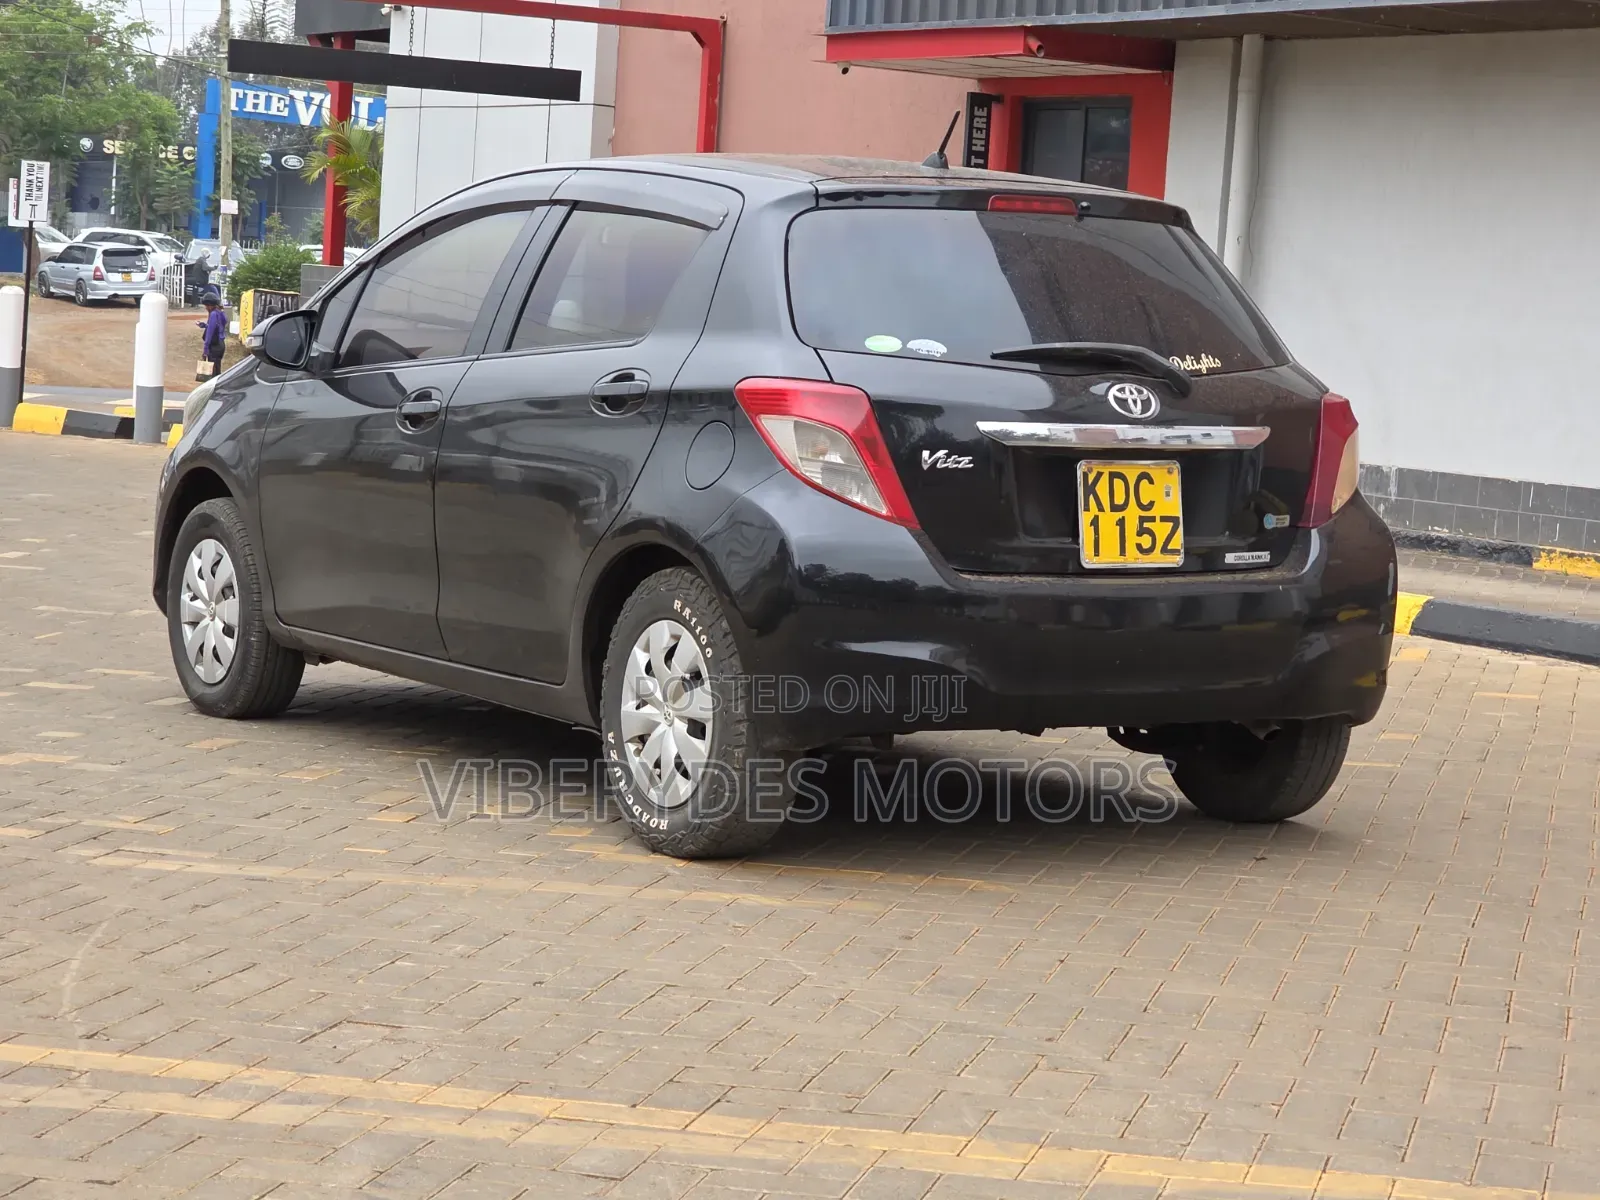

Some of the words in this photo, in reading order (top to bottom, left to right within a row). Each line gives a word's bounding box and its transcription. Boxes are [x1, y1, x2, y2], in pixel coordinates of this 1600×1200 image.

[231, 88, 289, 117] THE
[972, 106, 987, 151] HERE
[26, 163, 35, 177] YOU
[25, 178, 35, 202] THANK
[35, 176, 44, 193] NEXT
[1169, 353, 1222, 374] Delights
[922, 450, 974, 470] Vitz
[1082, 470, 1156, 513] KDC
[1089, 514, 1181, 557] 115Z
[607, 731, 669, 830] ROADCRUZA
